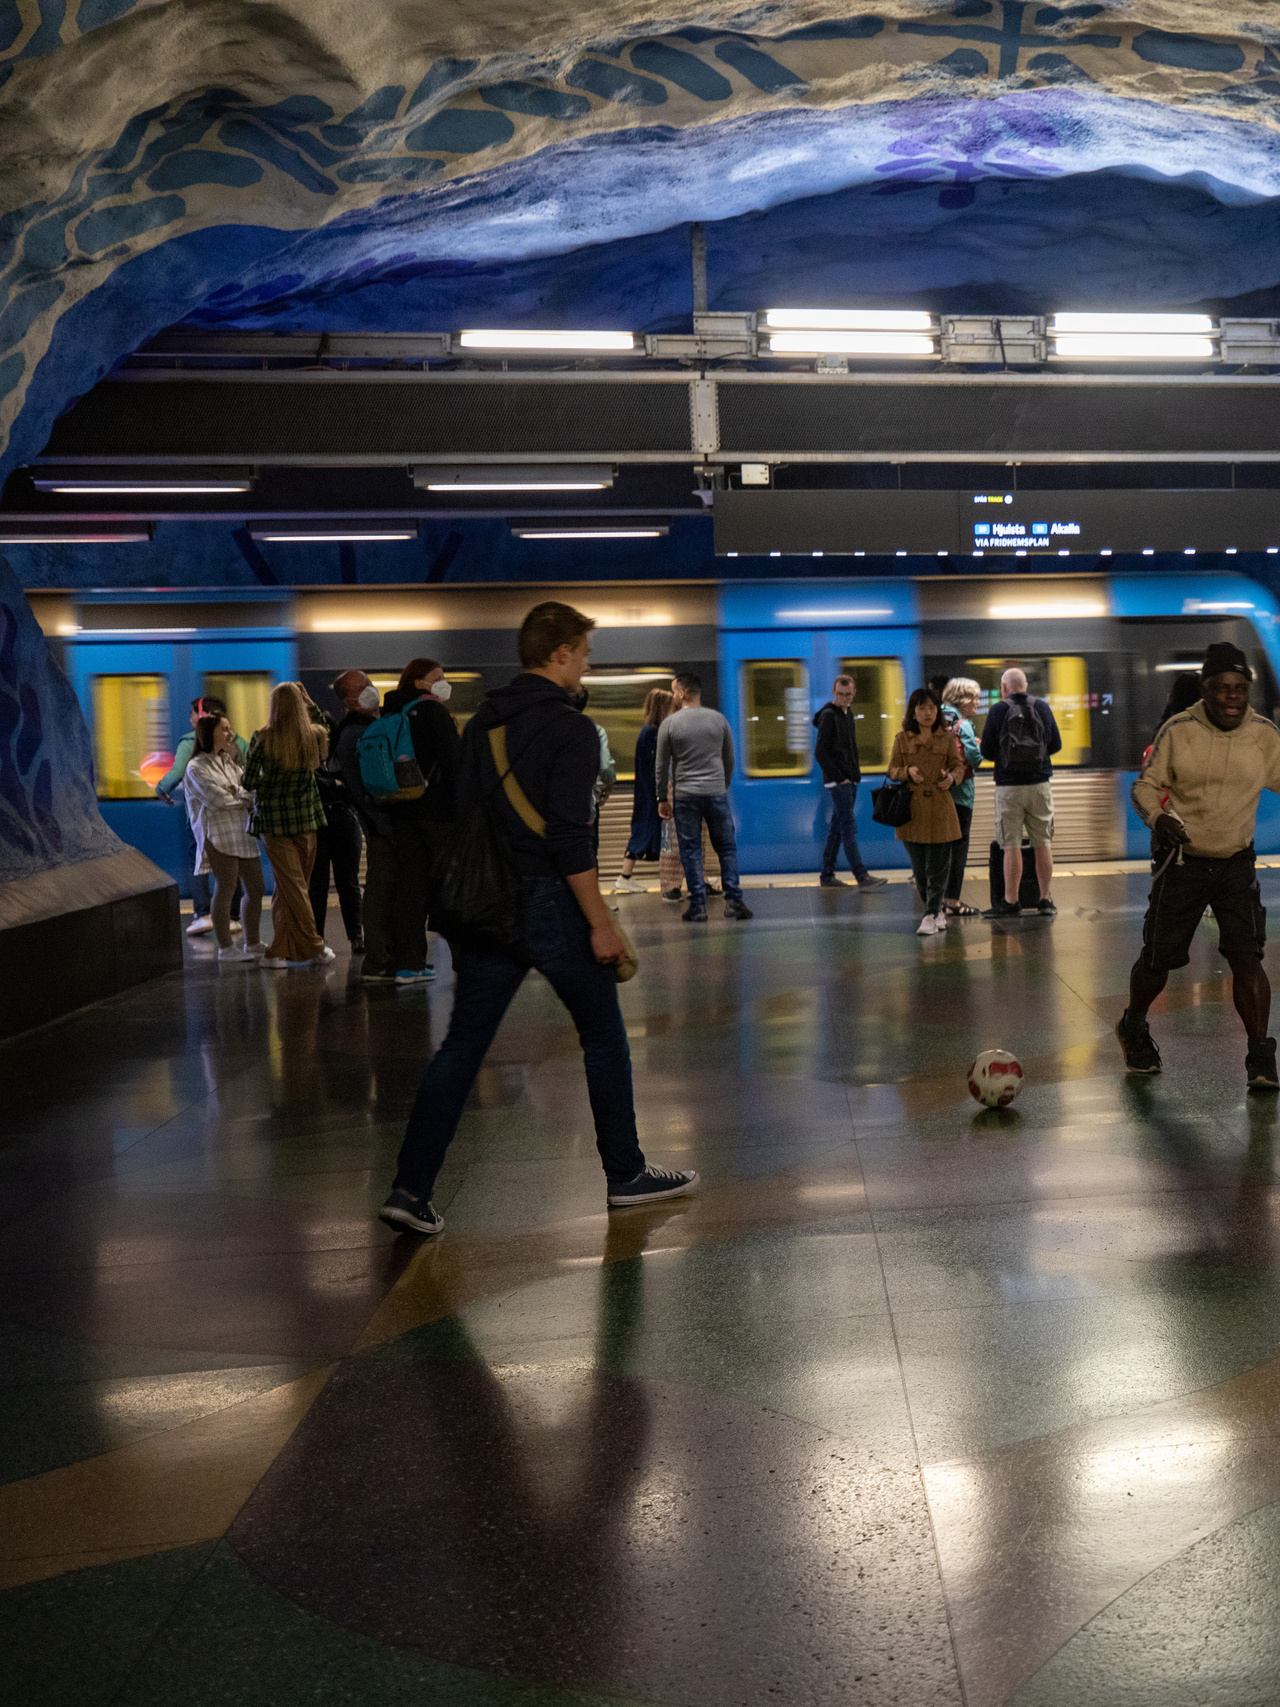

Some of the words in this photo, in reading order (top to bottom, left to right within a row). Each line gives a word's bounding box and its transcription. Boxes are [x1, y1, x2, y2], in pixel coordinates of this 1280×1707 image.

[993, 524, 1025, 536] Hjulsta
[975, 538, 989, 547] VIA
[990, 538, 1049, 547] FRIDHEMSPLAN
